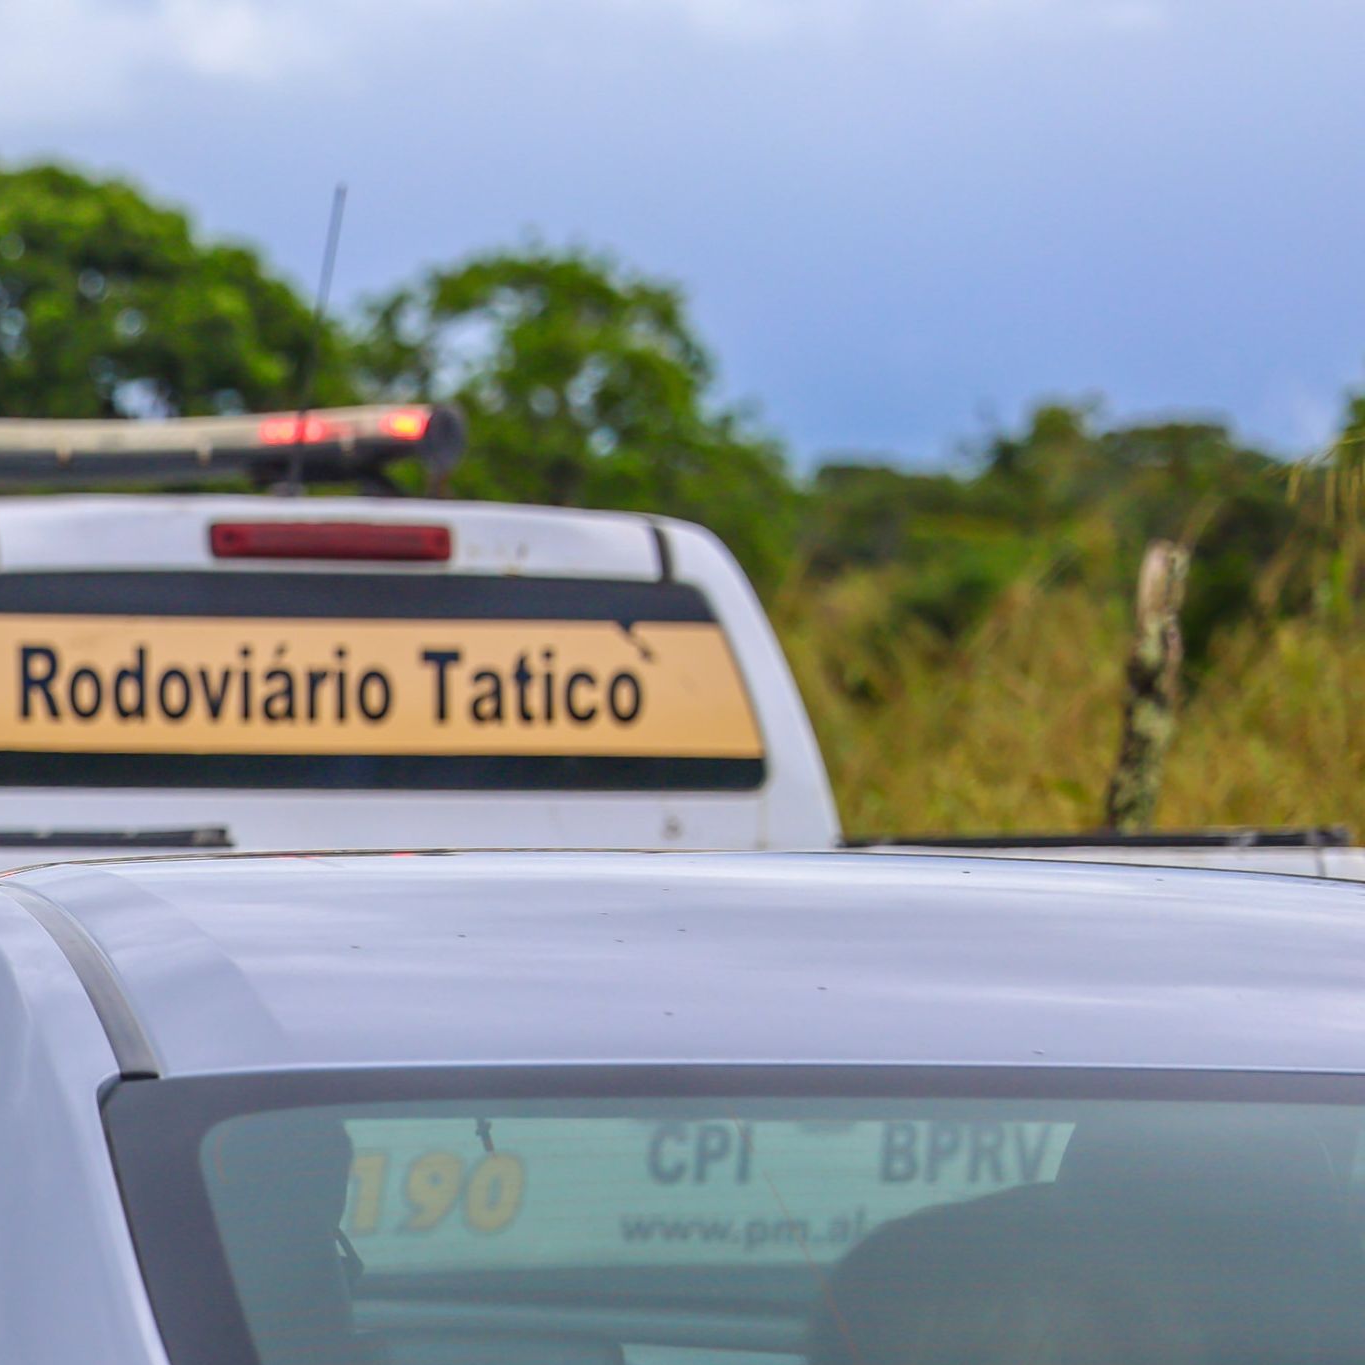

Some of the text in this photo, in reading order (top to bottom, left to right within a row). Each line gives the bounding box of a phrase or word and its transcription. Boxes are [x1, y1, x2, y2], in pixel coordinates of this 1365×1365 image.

[17, 643, 394, 724] Rodoviário
[349, 1151, 527, 1234] 190
[646, 1121, 1051, 1184] CPI BPRV
